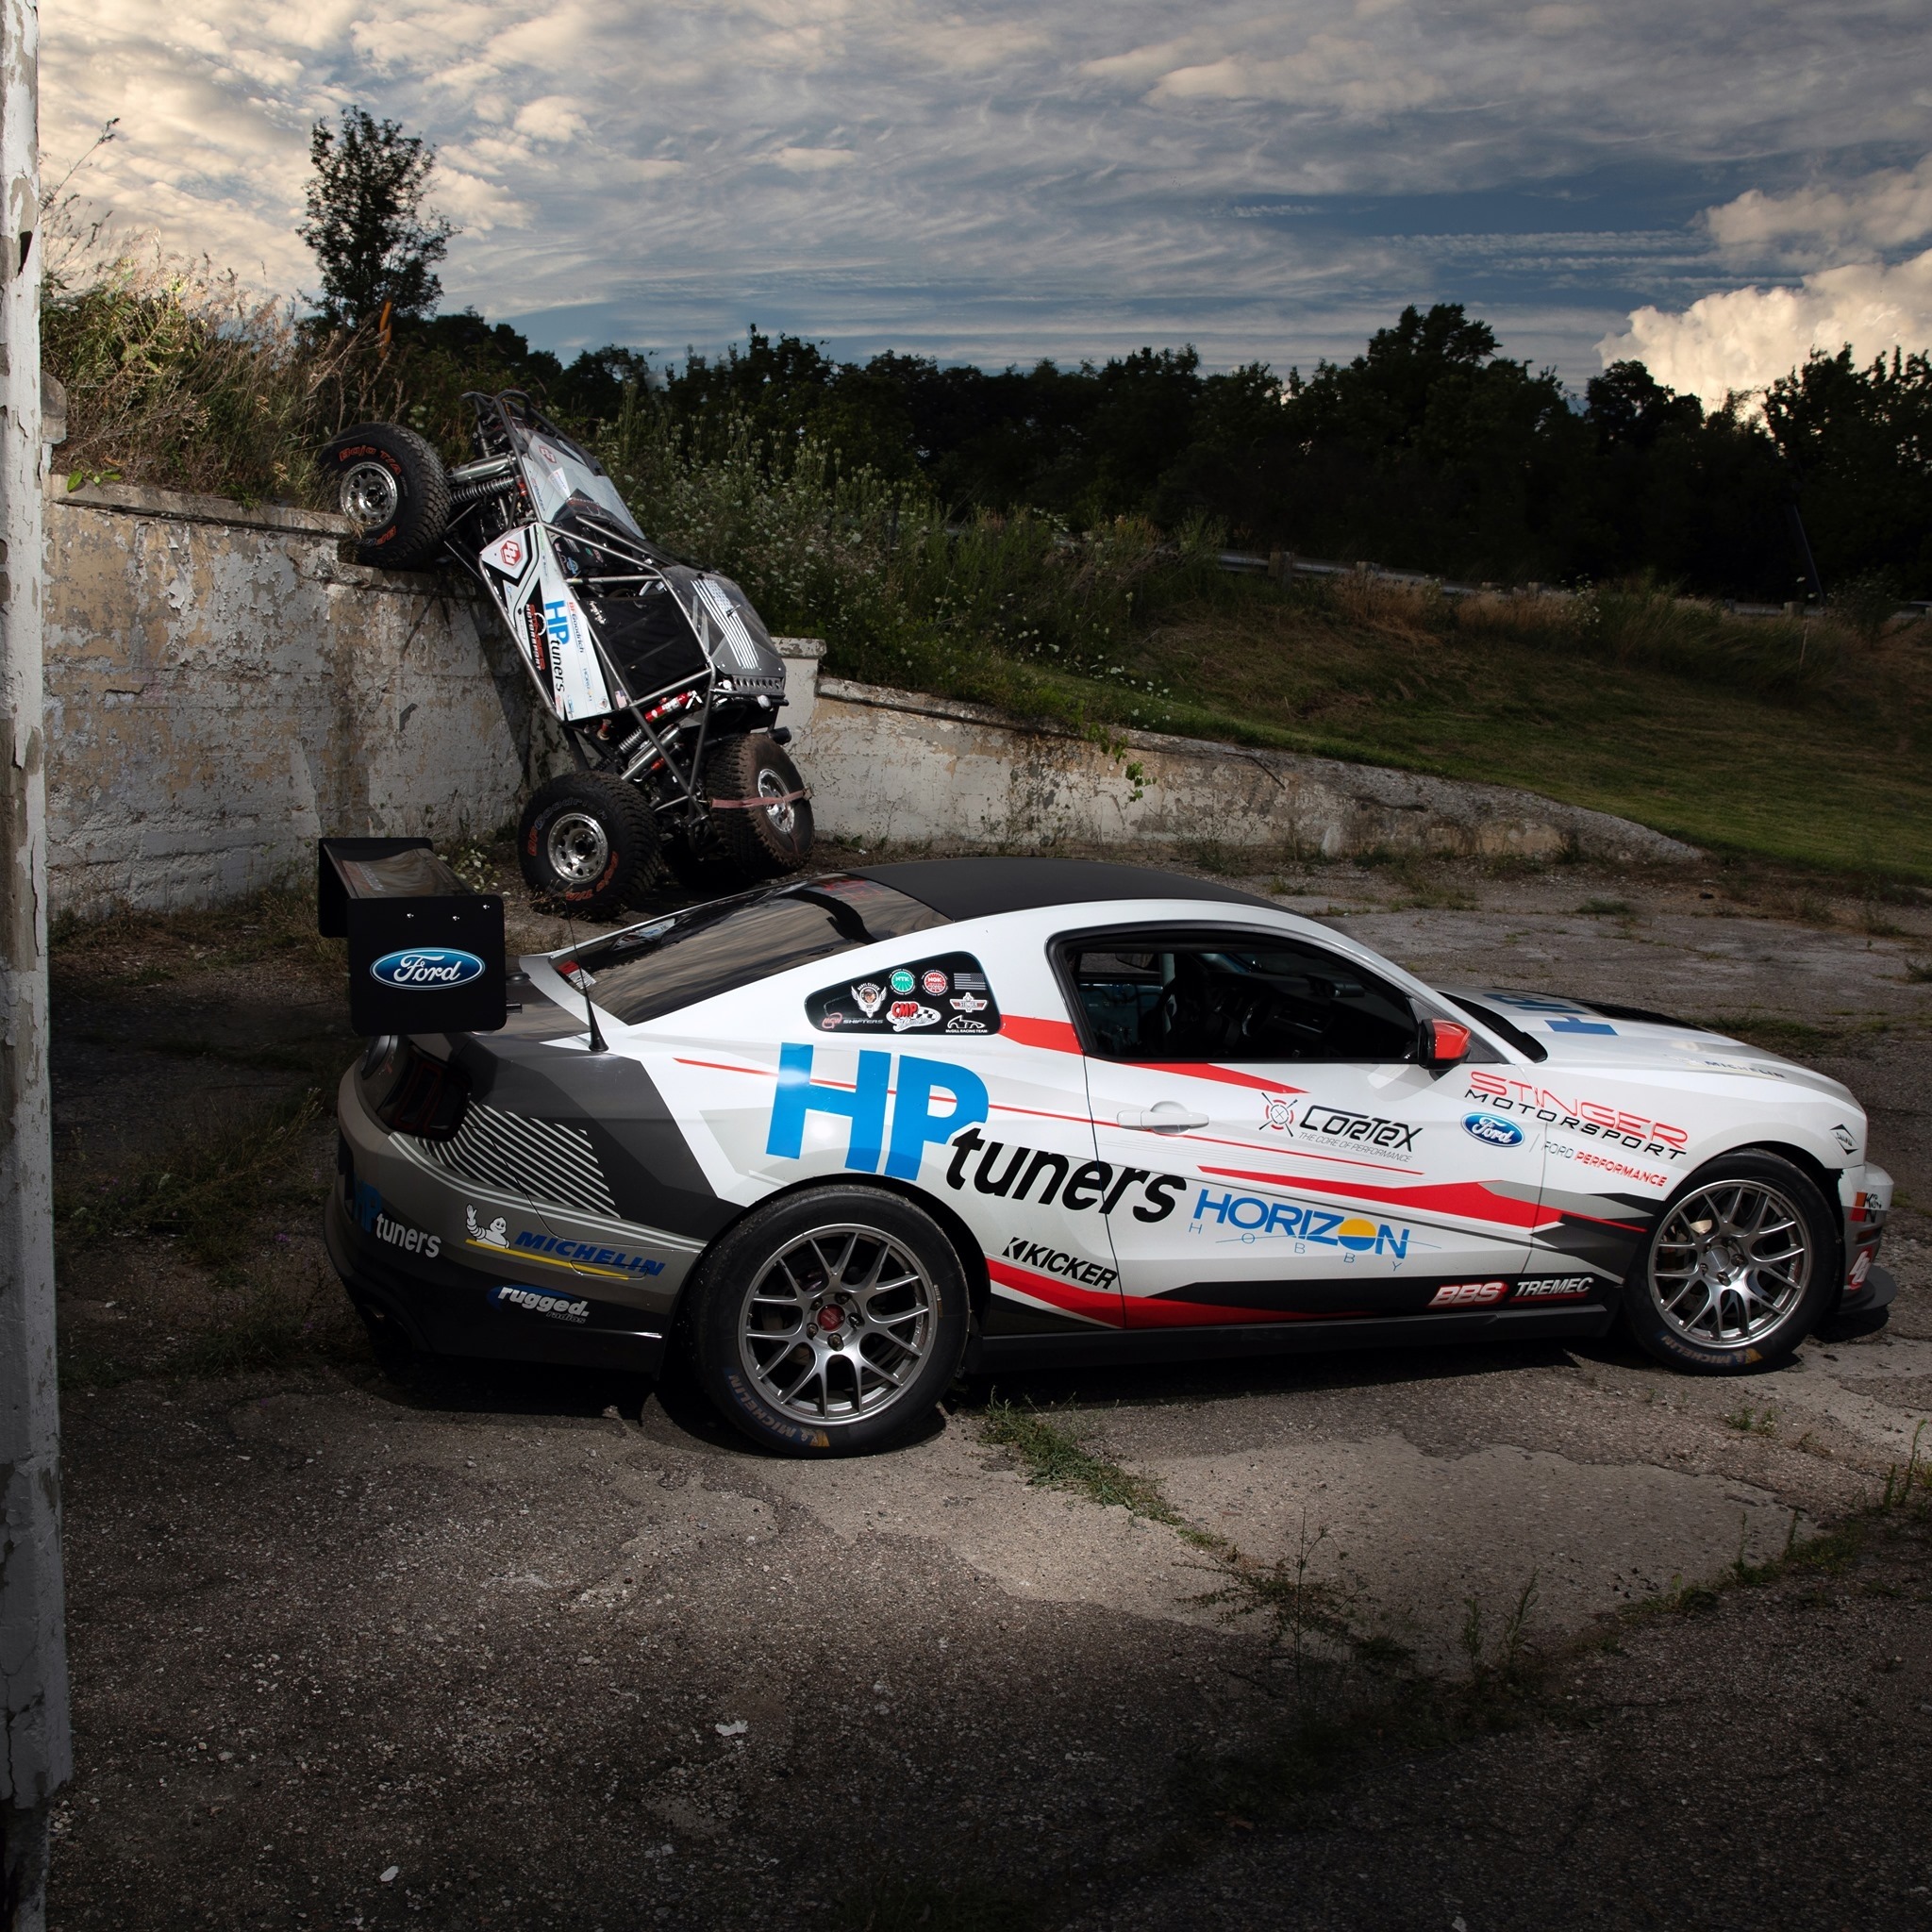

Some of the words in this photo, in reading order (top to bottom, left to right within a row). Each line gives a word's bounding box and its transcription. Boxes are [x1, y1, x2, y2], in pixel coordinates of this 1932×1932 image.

[338, 445, 377, 462] Baja
[544, 599, 571, 645] HP
[568, 601, 585, 654] BFGoodrich
[549, 638, 566, 692] tuners
[392, 954, 462, 982] Ford
[891, 1002, 919, 1019] CMP
[765, 1041, 990, 1182] HP
[945, 1126, 1188, 1224] tuners
[1464, 1089, 1688, 1160] MOTORSPORT
[1470, 1071, 1689, 1151] STINGER
[1471, 1116, 1512, 1144] Ford
[1298, 1131, 1316, 1141] THE
[1315, 1134, 1341, 1147] CORE
[1339, 1140, 1353, 1149] OF
[1350, 1143, 1413, 1163] PERFORMANCE
[1541, 1141, 1575, 1160] FORD
[1574, 1151, 1668, 1188] PERFORMANCE
[375, 1212, 442, 1258] tuners
[1192, 1189, 1410, 1259] HORIZON
[515, 1230, 666, 1276] MICHELIN
[1024, 1245, 1119, 1291] KICKER
[1426, 1281, 1507, 1308] BBS
[1515, 1276, 1595, 1298] TREMEC
[545, 1310, 586, 1324] radios
[1659, 1334, 1733, 1365] MICHELIN
[727, 1374, 797, 1439] MICHELIN
